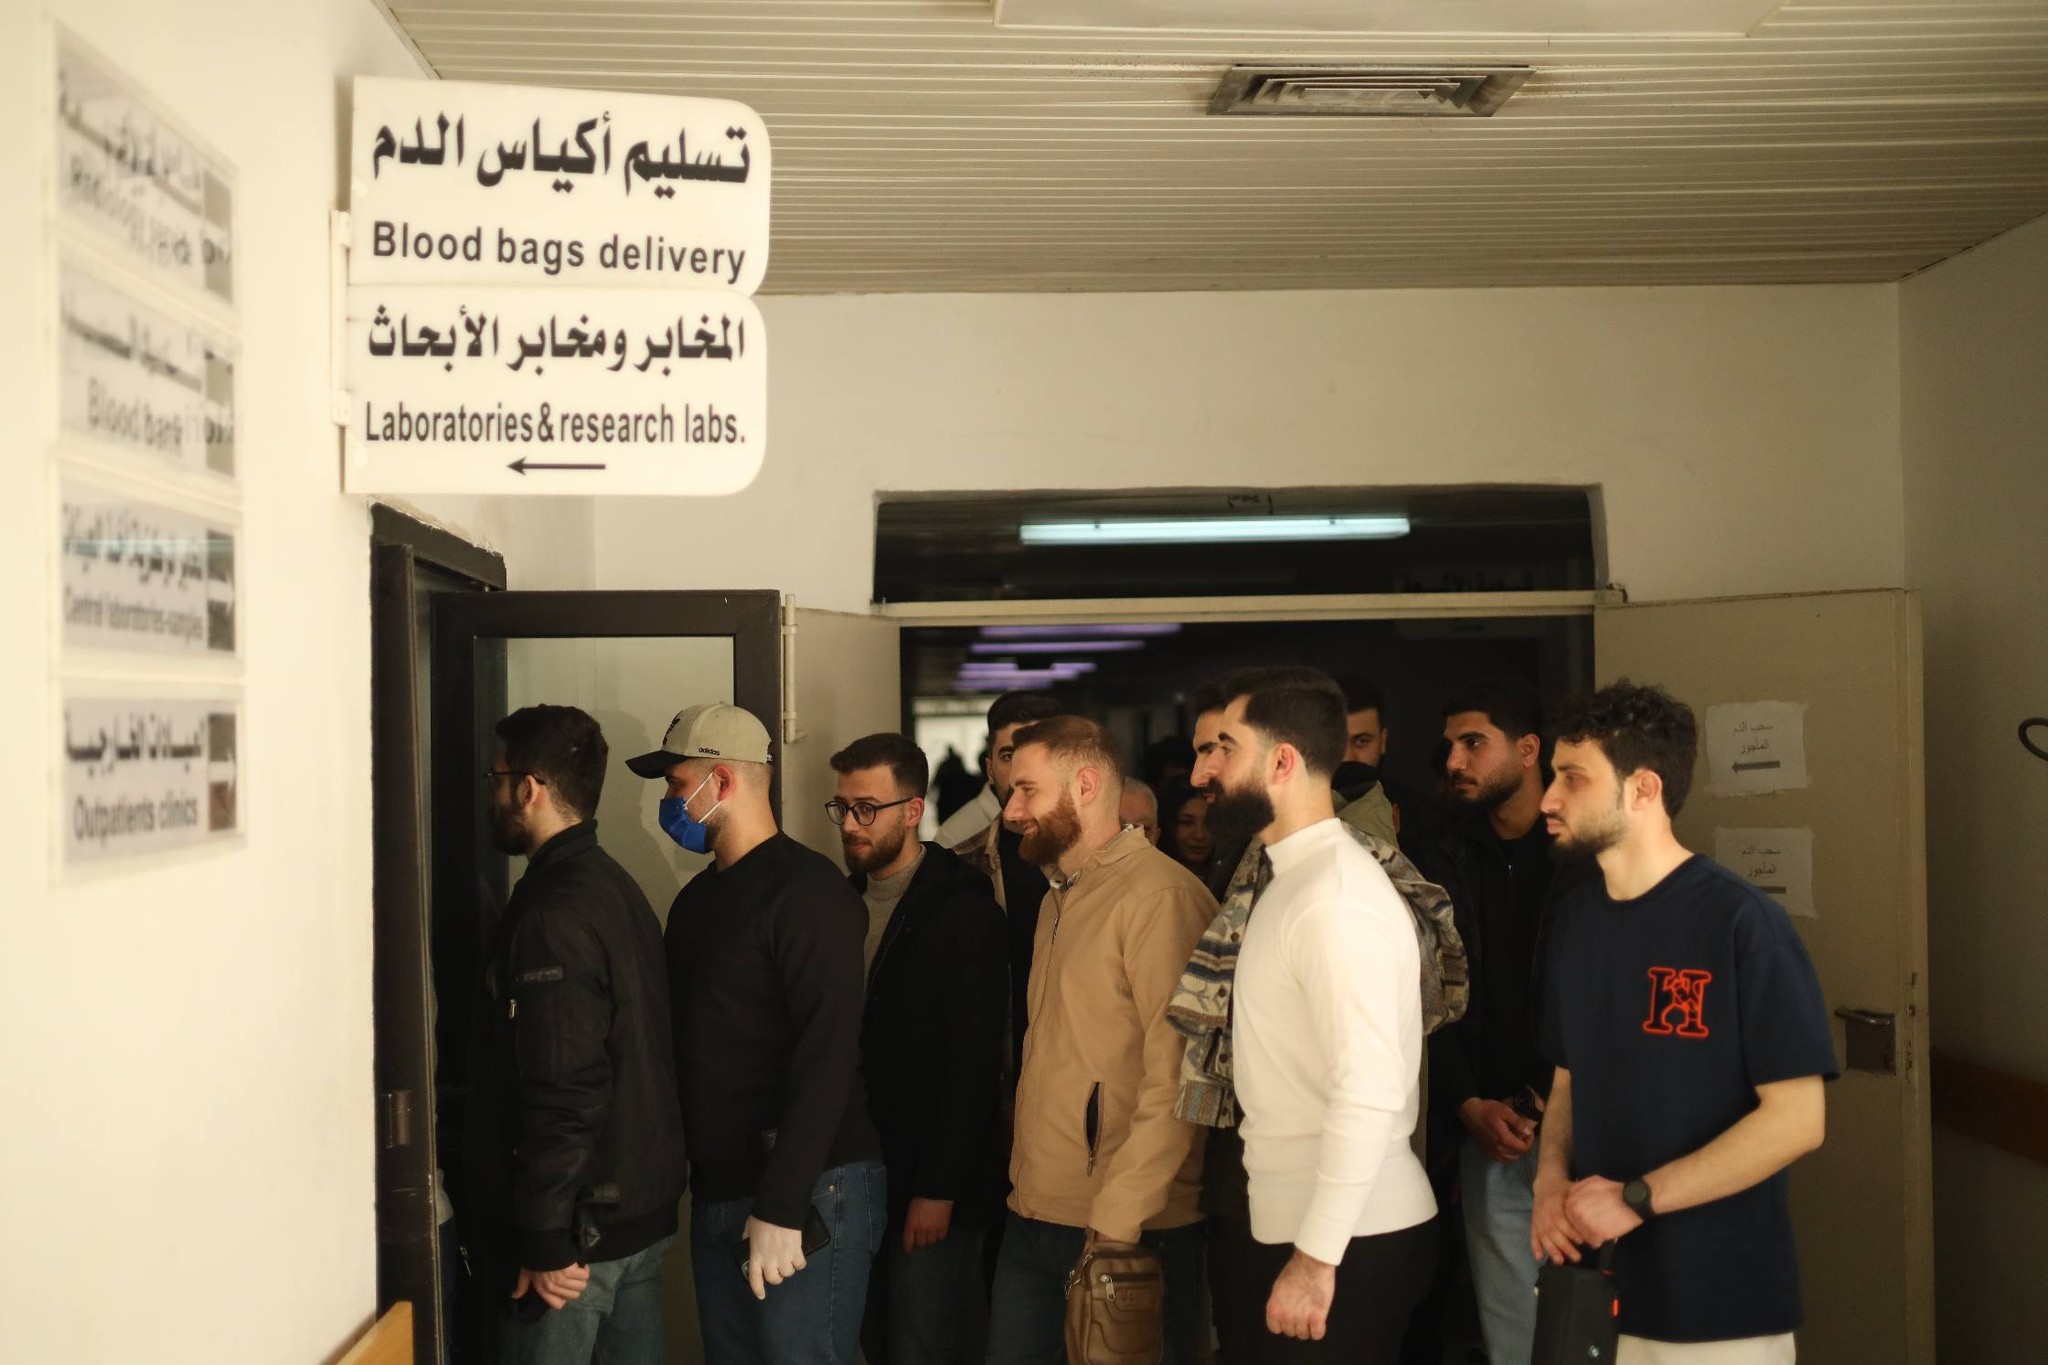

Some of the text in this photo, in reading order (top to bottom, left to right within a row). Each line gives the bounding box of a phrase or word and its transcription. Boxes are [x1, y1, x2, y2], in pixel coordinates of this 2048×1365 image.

[373, 110, 750, 198] تسليم أكياس الدم
[373, 221, 746, 285] Blood bags delivery
[368, 304, 745, 377] المخابر ومخابر الأبحاث
[685, 404, 746, 444] labs.
[698, 747, 720, 756] adidas
